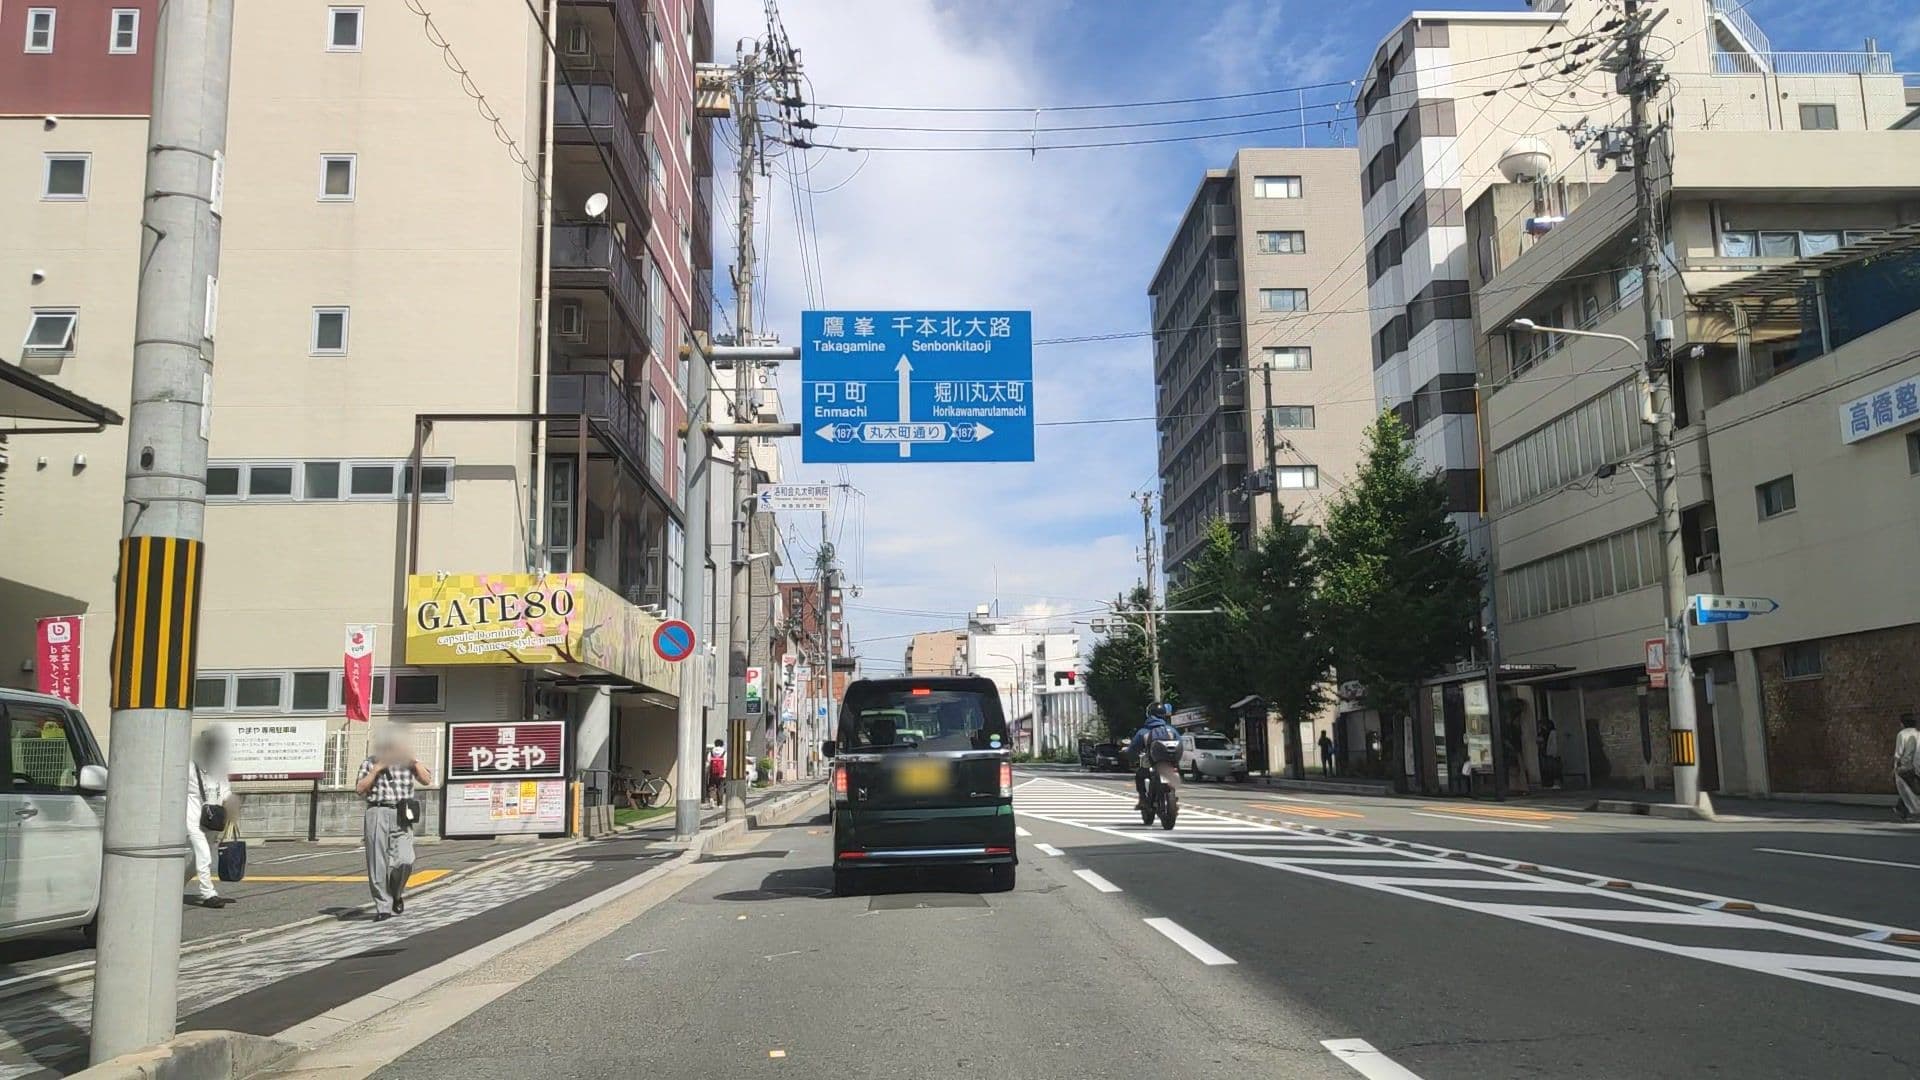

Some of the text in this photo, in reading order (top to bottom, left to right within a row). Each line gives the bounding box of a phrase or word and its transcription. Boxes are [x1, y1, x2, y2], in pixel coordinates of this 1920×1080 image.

[823, 317, 1011, 338] 鷹峯 千本北大路
[813, 340, 886, 353] Takagamine
[912, 340, 992, 354] Senbonkitaoji
[815, 383, 867, 403] 円町
[934, 382, 1025, 403] 堀川丸太町
[815, 406, 868, 418] Enmachi
[933, 405, 1027, 417] Horikawamarutamachi
[837, 428, 851, 439] 187
[870, 425, 940, 439] 丸太町通り
[958, 427, 972, 438] 187
[417, 589, 574, 631] GATE80
[438, 632, 476, 646] capsule
[456, 644, 467, 655] &
[746, 670, 759, 684] P
[468, 747, 546, 771] やまや
